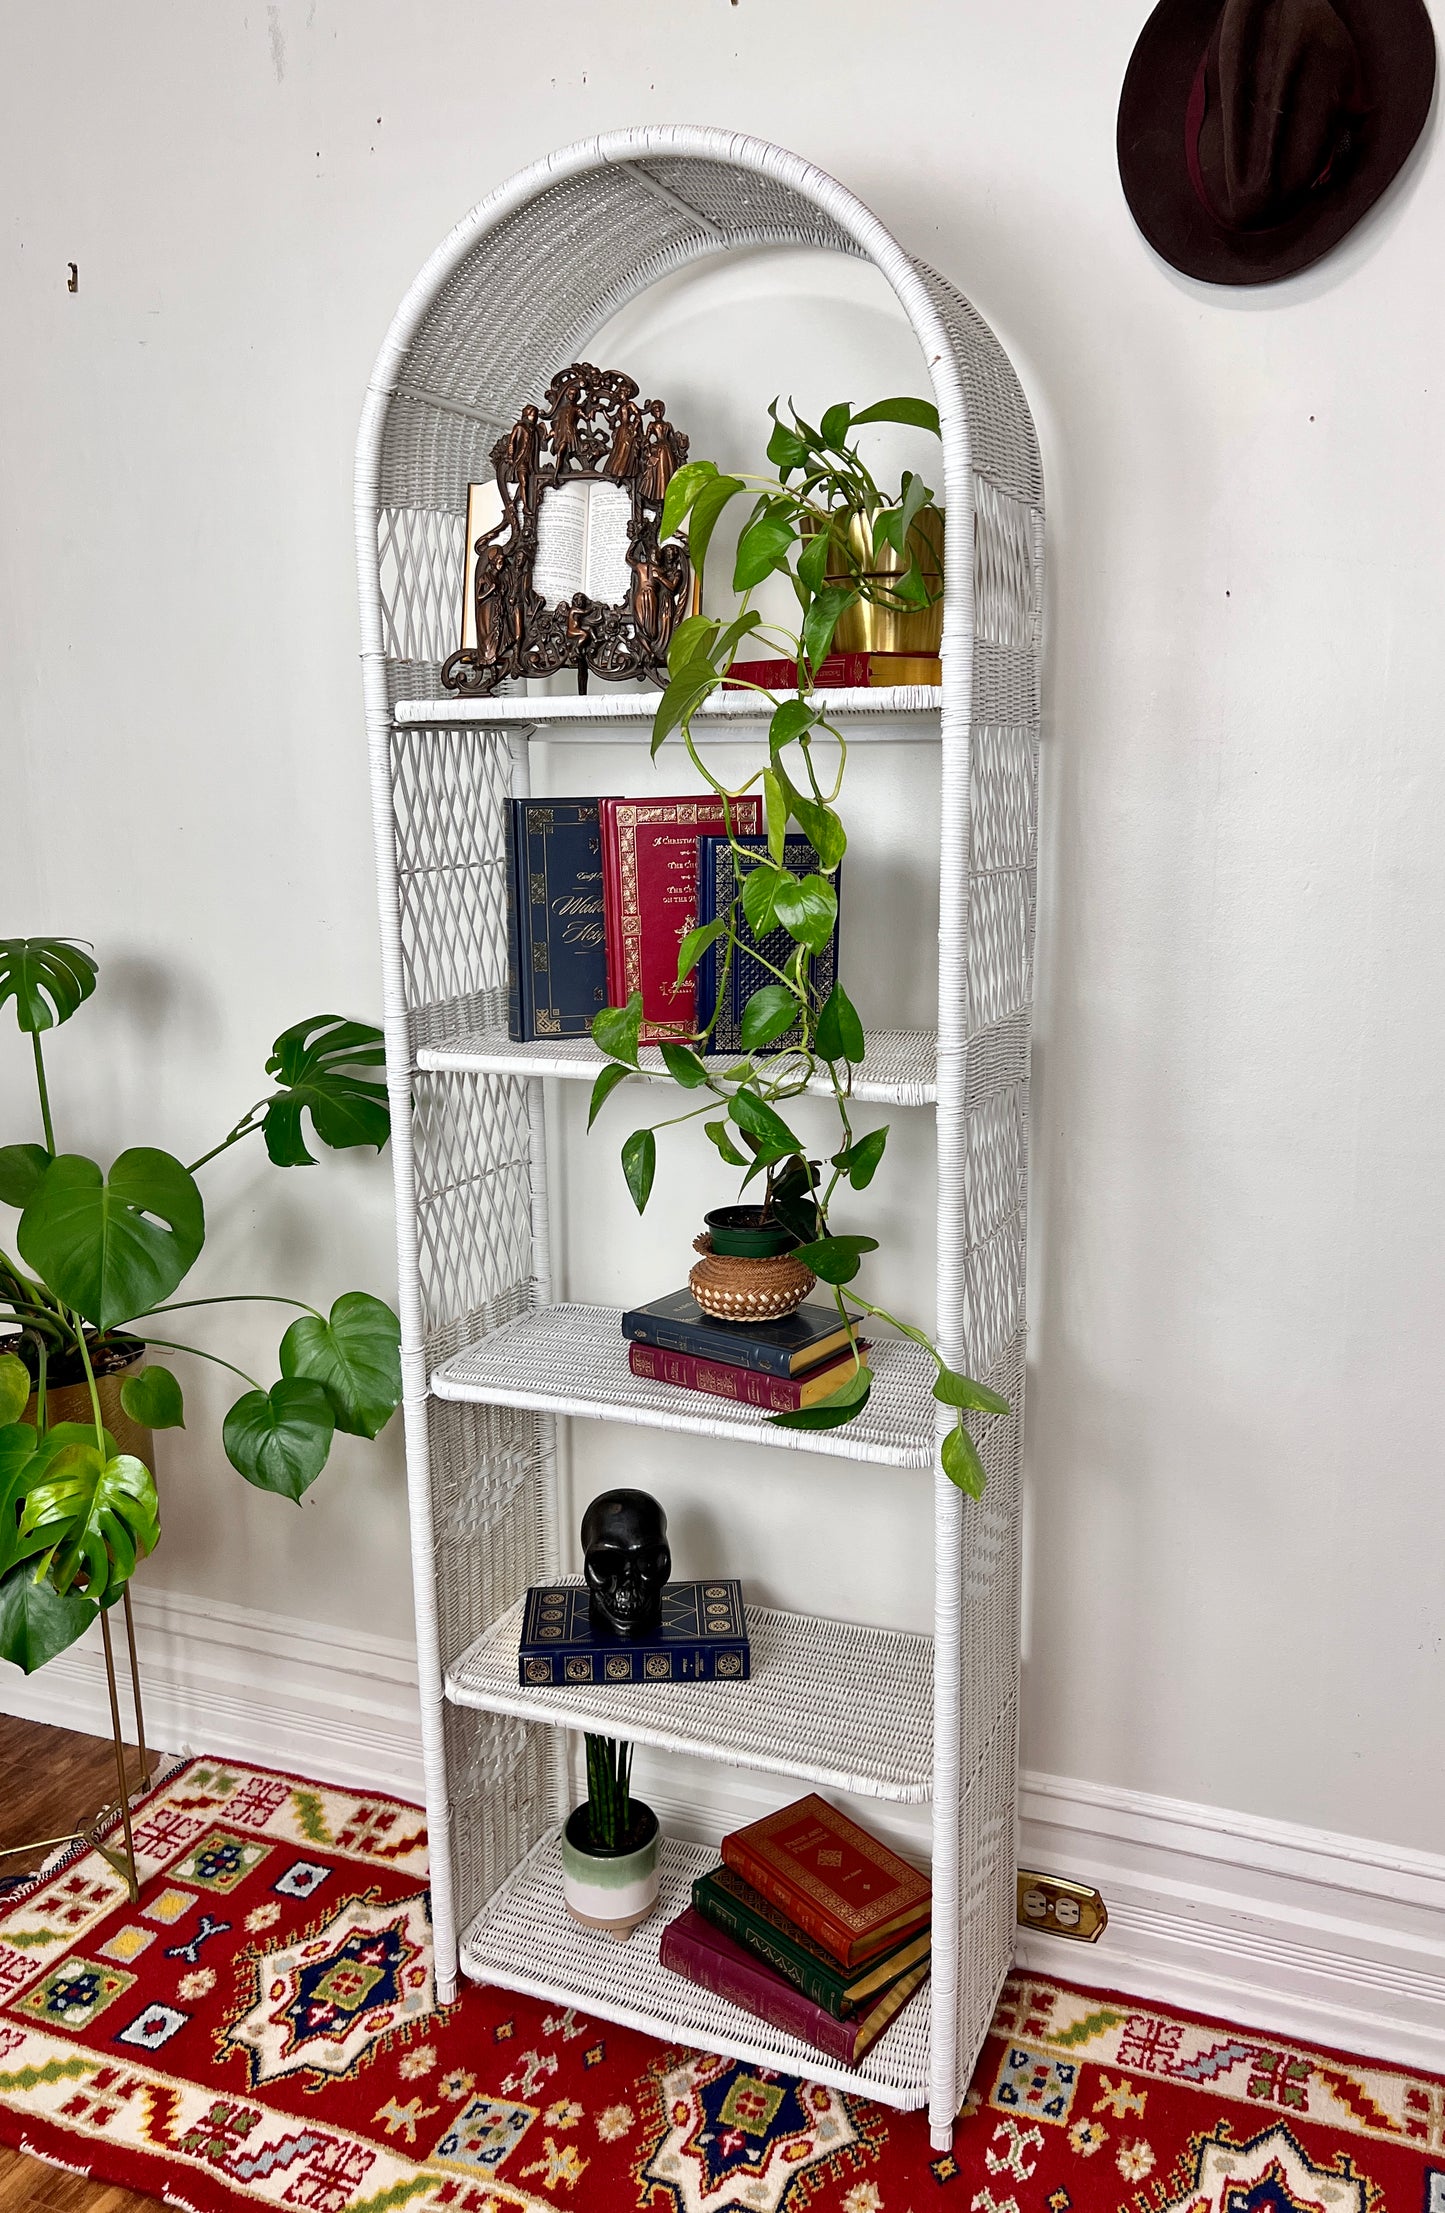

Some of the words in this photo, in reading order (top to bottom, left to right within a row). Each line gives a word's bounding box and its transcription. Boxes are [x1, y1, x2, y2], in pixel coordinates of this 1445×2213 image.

[652, 837, 662, 847] A
[662, 836, 696, 845] CHRISTM
[667, 862, 683, 870] THE
[667, 886, 683, 894] THE
[562, 921, 607, 948] Heig
